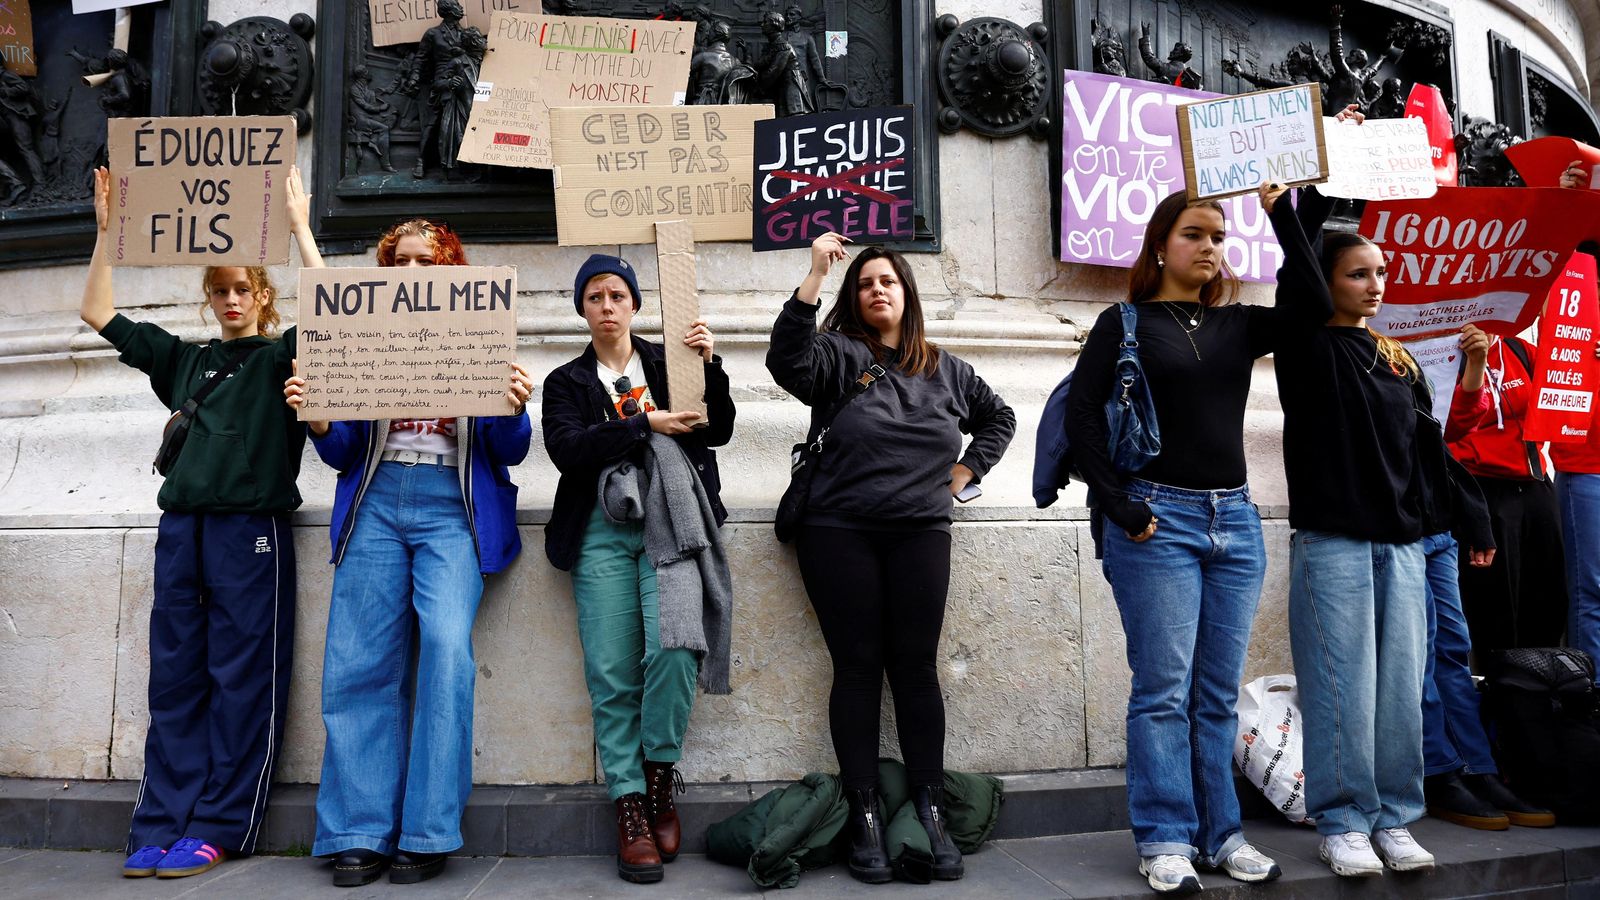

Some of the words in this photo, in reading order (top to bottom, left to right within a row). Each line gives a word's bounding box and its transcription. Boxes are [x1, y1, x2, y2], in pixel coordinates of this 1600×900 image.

[375, 3, 395, 24] LE
[498, 17, 538, 44] POUR
[548, 23, 576, 46] EN
[639, 28, 685, 54] AVEC
[546, 51, 564, 71] LE
[572, 52, 624, 77] MYTHE
[630, 57, 652, 78] DU
[568, 83, 653, 104] MONSTRE
[1231, 96, 1266, 125] ALL
[496, 133, 529, 146] VIOLEUR
[530, 137, 541, 147] EN
[582, 111, 727, 144] CEDER
[1230, 123, 1271, 154] BUT
[135, 120, 284, 167] ÉDUQUEZ
[759, 127, 818, 171] JE
[824, 116, 905, 162] SUIS
[483, 153, 501, 161] POUR
[505, 153, 529, 163] VIOLER
[596, 150, 648, 173] N'EST
[669, 144, 730, 174] PAS
[1073, 143, 1127, 176] on
[1129, 144, 1176, 184] te
[1200, 160, 1260, 196] ALWAYS
[1266, 149, 1318, 181] MENS
[181, 179, 231, 205] VOS
[766, 197, 913, 242] GISÈLE
[1371, 210, 1527, 250] 160000
[1067, 227, 1132, 260] on
[315, 281, 388, 316] NOT
[391, 281, 441, 313] ALL
[450, 279, 512, 311] MEN
[1420, 305, 1465, 317] VICTIMES
[1467, 302, 1479, 312] DE
[1559, 288, 1581, 317] 18
[302, 330, 332, 342] Mais
[339, 329, 352, 340] ton
[388, 329, 405, 339] ton
[448, 328, 462, 338] ton
[1388, 316, 1445, 330] VIOLENCES
[1555, 324, 1592, 342] ENFANTS
[306, 346, 323, 355] ton
[355, 345, 370, 354] ton
[373, 344, 408, 353] meilleur
[436, 344, 453, 352] ton
[1551, 347, 1558, 361] &
[1559, 348, 1581, 363] ADOS
[304, 372, 320, 381] ton
[361, 371, 376, 381] ton
[412, 373, 427, 381] ton
[460, 373, 470, 381] de
[305, 359, 325, 368] ton
[328, 360, 348, 368] coach
[400, 359, 432, 369] rappeur
[466, 357, 482, 367] ton
[304, 385, 322, 395] ton
[353, 386, 370, 395] ton
[413, 386, 431, 394] ton
[459, 387, 474, 395] ton
[1541, 392, 1560, 406] PAR
[1560, 394, 1588, 408] HEURE
[301, 399, 321, 409] ton
[374, 399, 391, 409] ton
